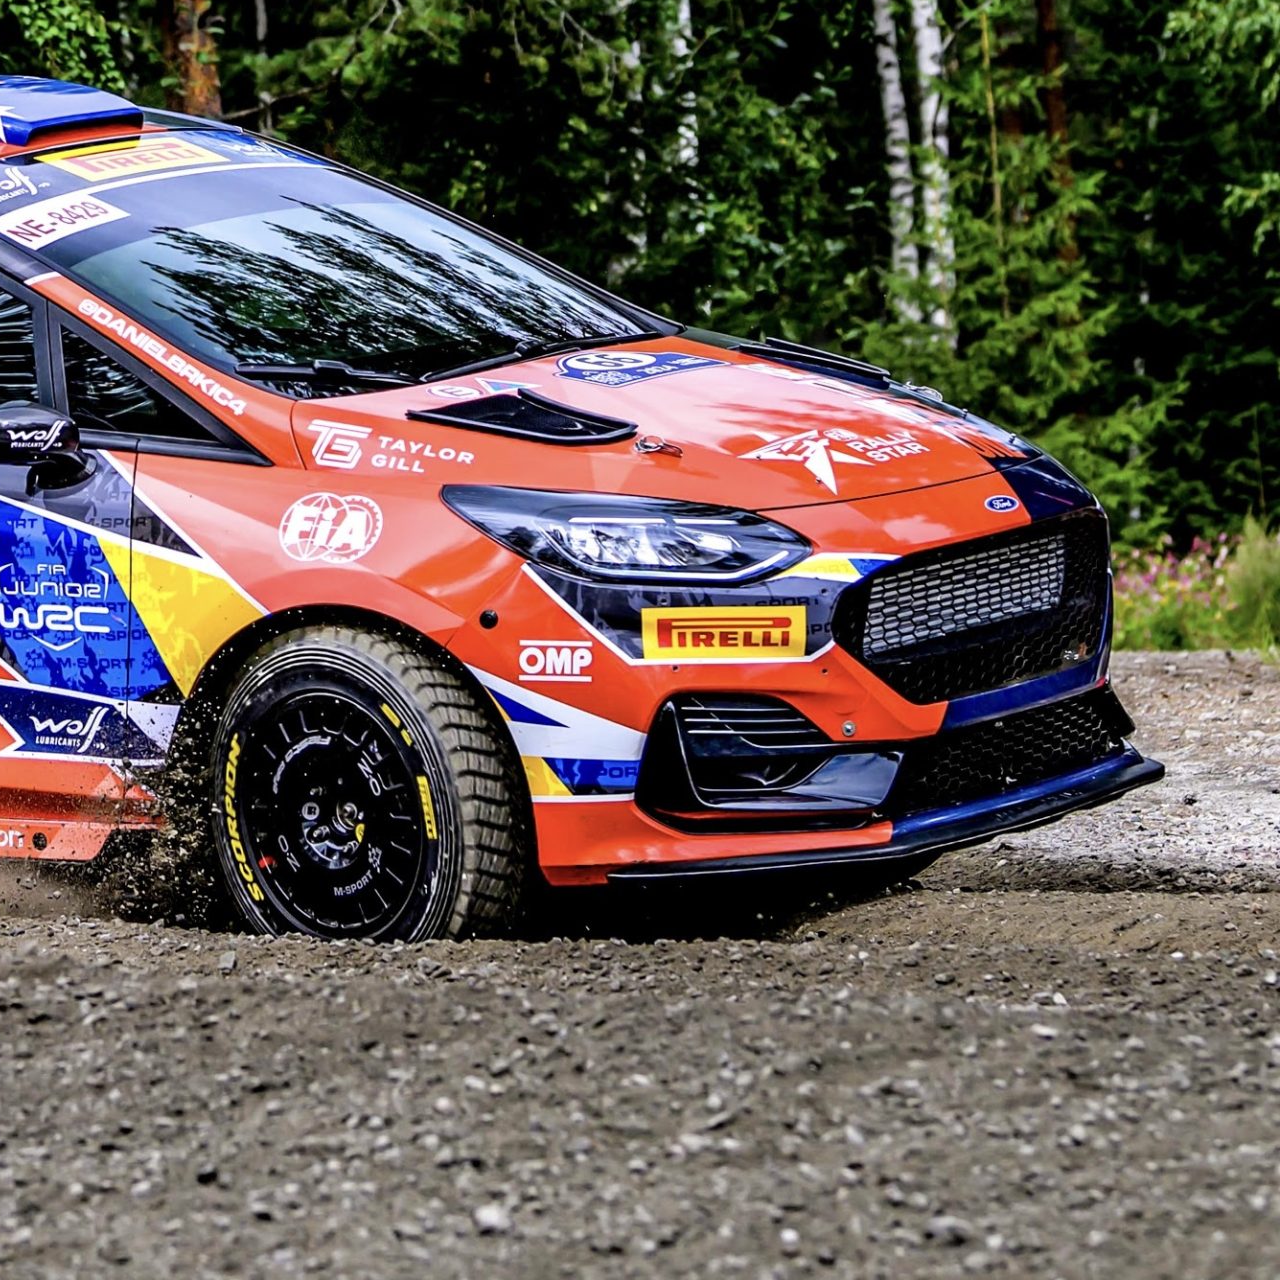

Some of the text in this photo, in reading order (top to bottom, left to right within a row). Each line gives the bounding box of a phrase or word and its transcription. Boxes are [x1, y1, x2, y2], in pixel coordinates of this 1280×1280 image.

[61, 143, 203, 172] PIRELLI
[7, 201, 109, 243] NE-8429
[77, 298, 248, 416] @DANIELBRKIC4
[7, 420, 66, 451] wolf
[378, 435, 474, 464] TAYLOR
[846, 431, 917, 452] RALLY
[371, 454, 425, 473] GILL
[866, 442, 931, 462] STAR
[992, 499, 1012, 509] Ford
[37, 564, 66, 575] FIA
[657, 617, 792, 648] PIRELLI
[519, 647, 593, 674] OMP
[29, 706, 110, 753] wolf
[35, 735, 81, 748] LUBRICANTS
[224, 732, 264, 901] SCORPION
[334, 870, 374, 897] M-SPORT
